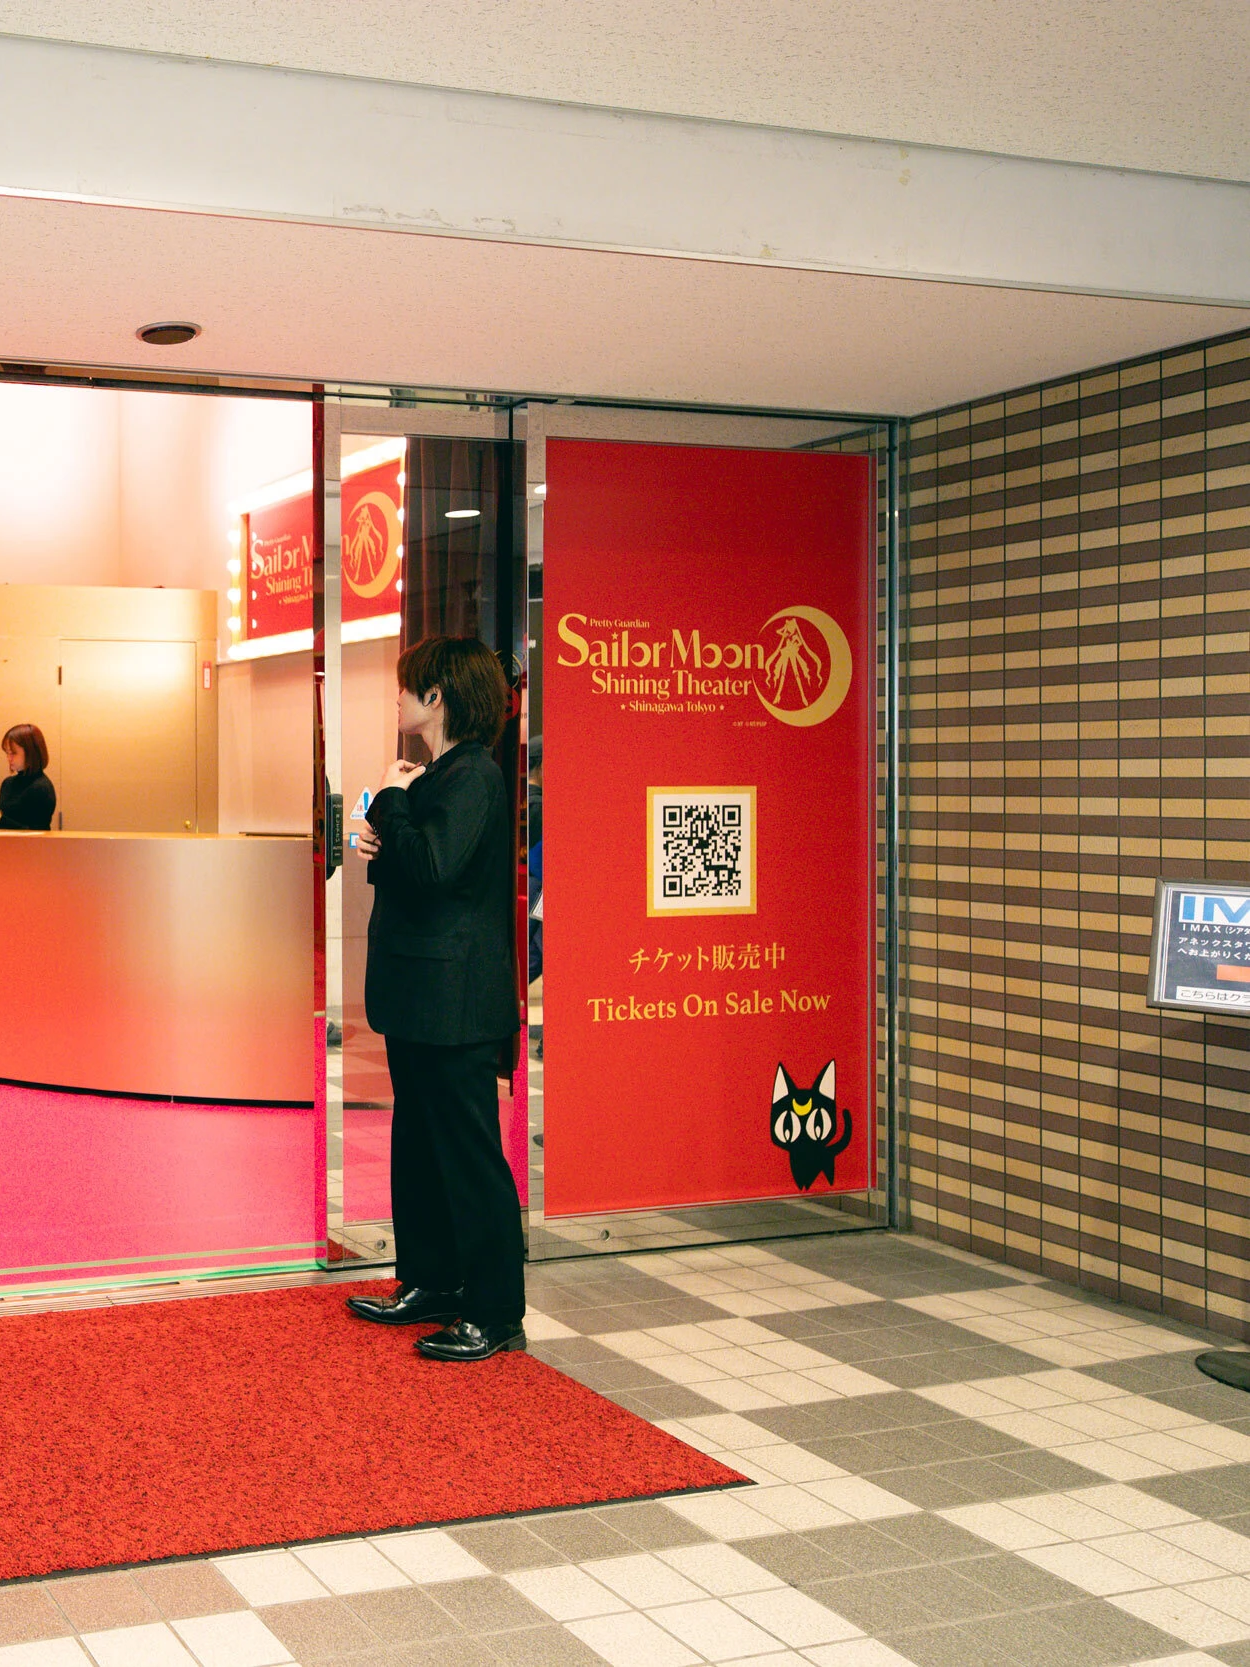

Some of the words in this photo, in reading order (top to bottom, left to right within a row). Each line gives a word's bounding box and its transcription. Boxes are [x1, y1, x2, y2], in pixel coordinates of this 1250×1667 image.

[251, 539, 300, 579] Sailor
[266, 575, 302, 596] Shining
[590, 618, 614, 629] Pretty
[615, 618, 650, 629] Guardian
[557, 613, 667, 667] Sailor
[670, 629, 765, 669] Moon
[591, 669, 670, 700] Shining
[672, 669, 752, 695] Theater
[629, 700, 684, 715] Shinagawa
[686, 701, 716, 715] Tokyo
[629, 942, 785, 975] チケット販売中
[588, 996, 676, 1022] Tickets
[683, 993, 719, 1018] On
[725, 990, 773, 1015] Sale
[780, 989, 831, 1013] Now
